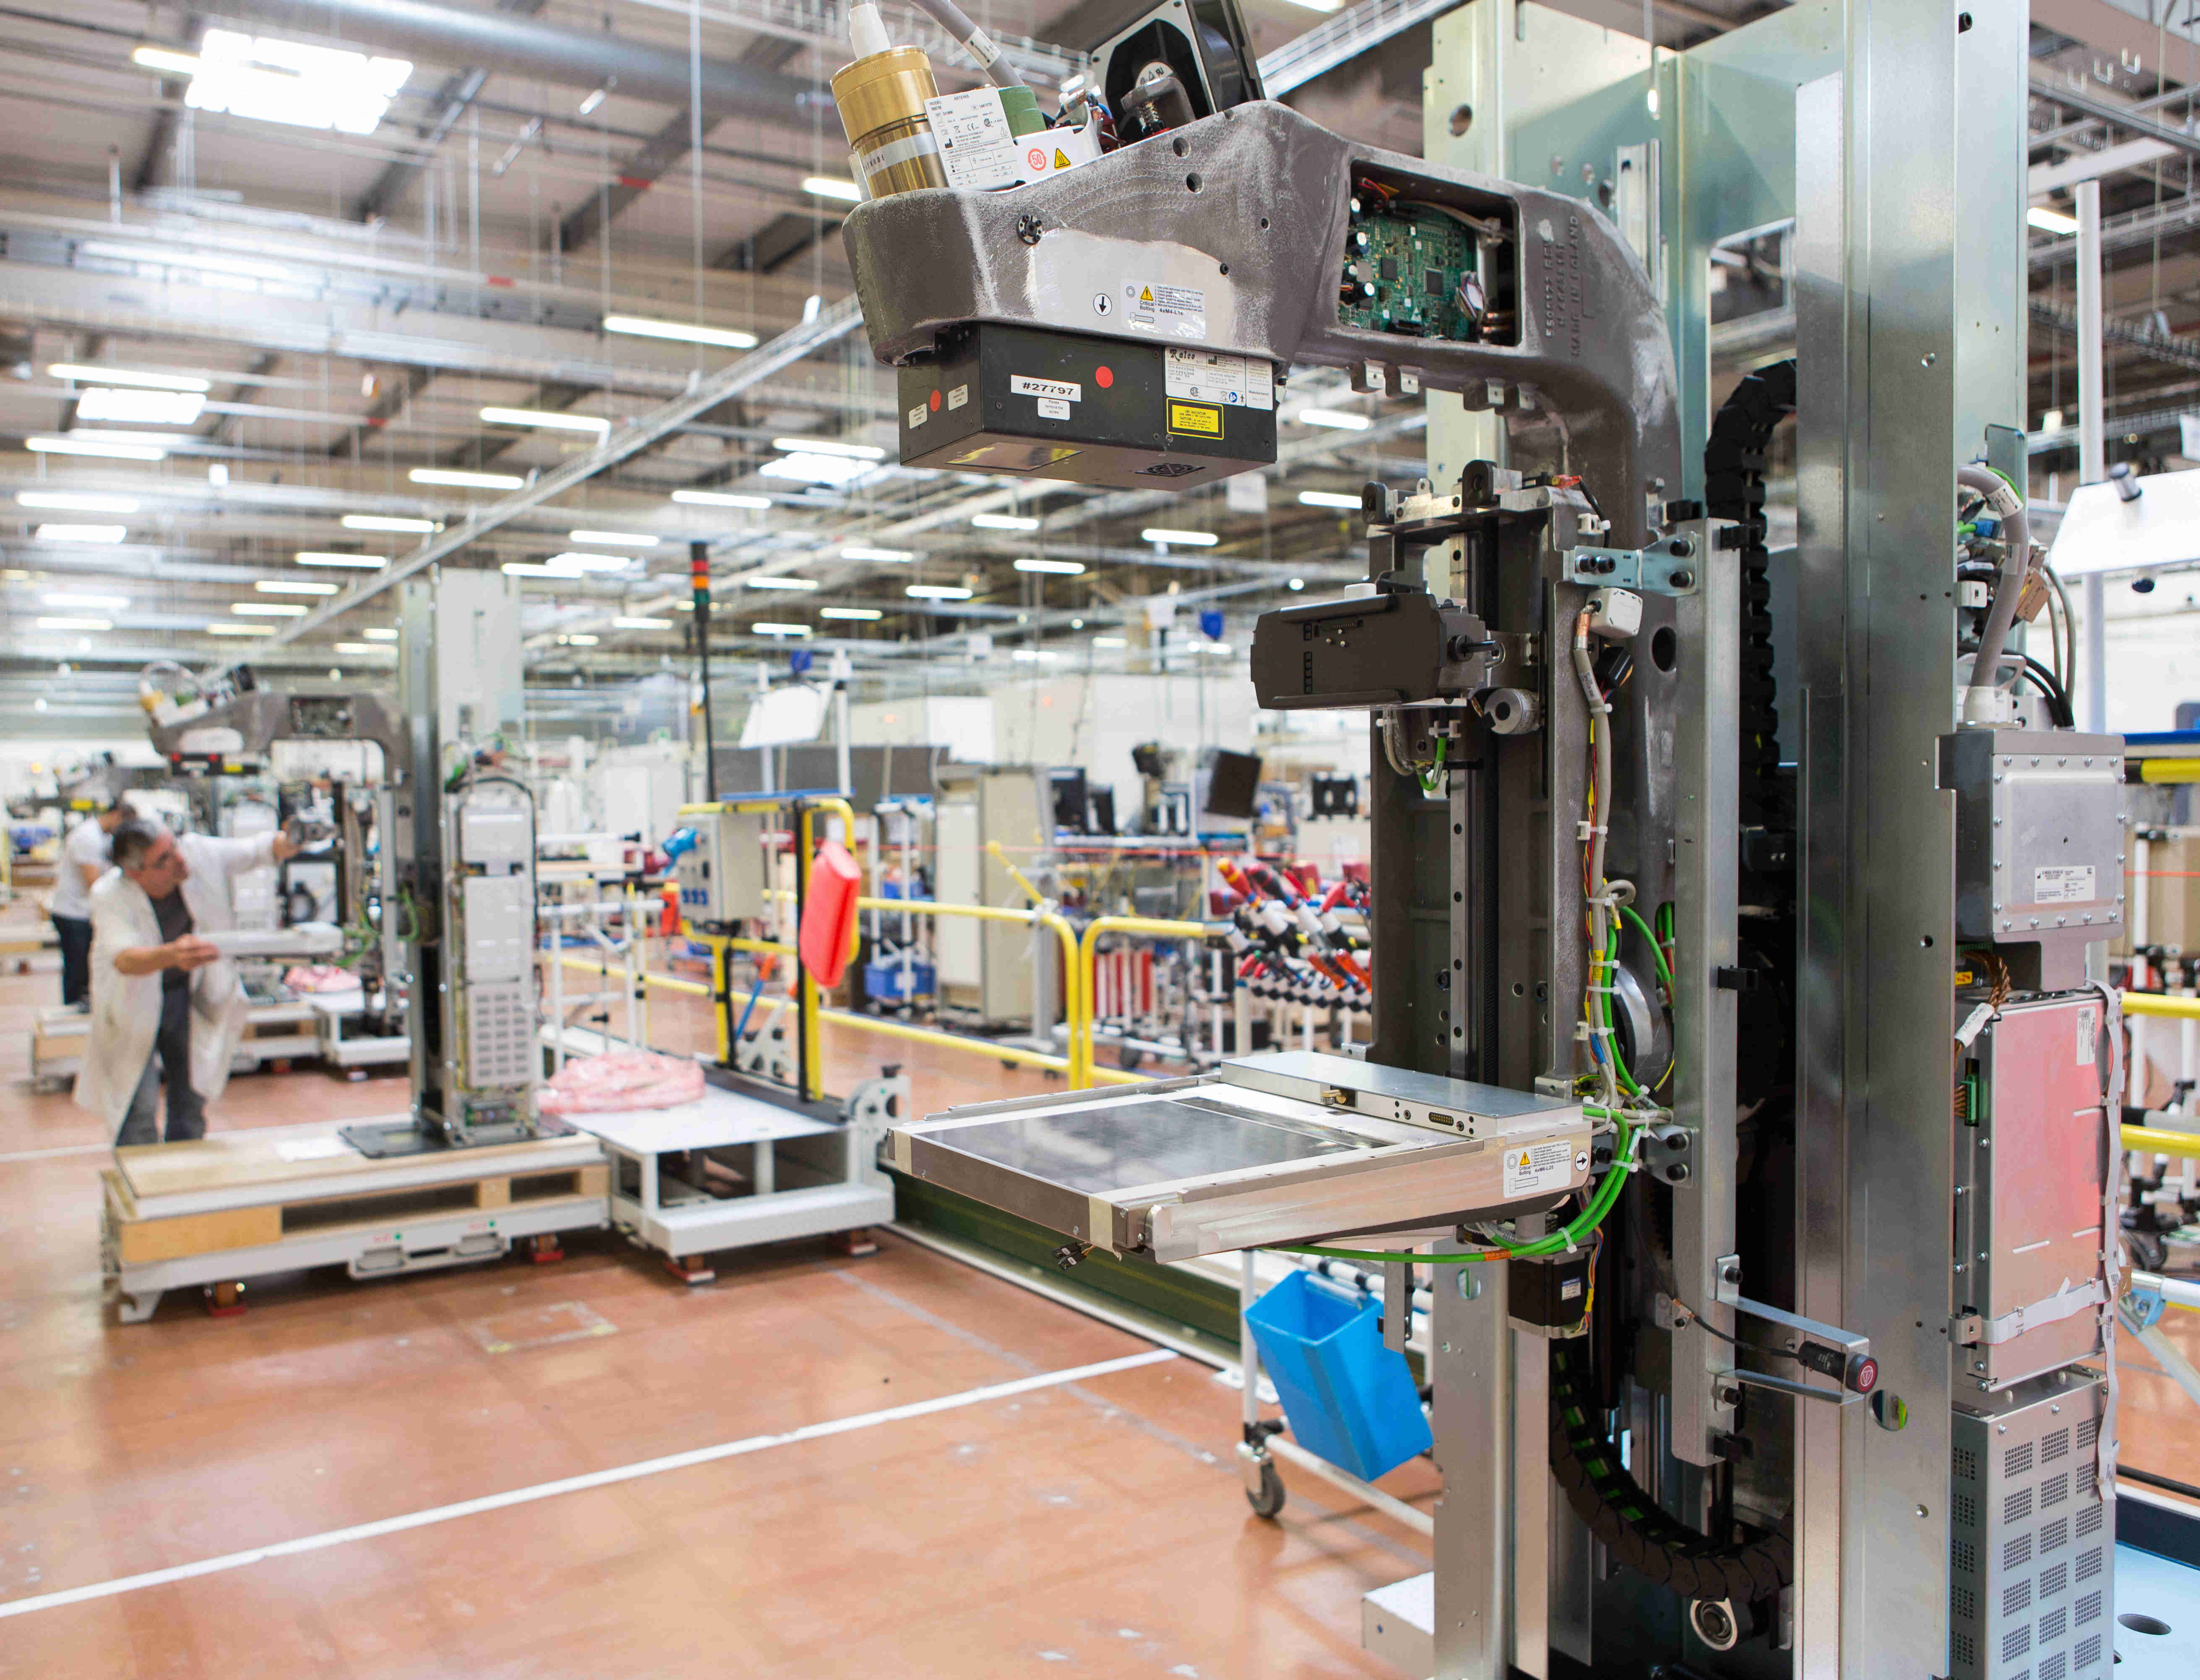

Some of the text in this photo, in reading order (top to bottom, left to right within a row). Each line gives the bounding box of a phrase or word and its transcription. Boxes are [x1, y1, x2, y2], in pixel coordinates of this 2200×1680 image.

[1032, 154, 1043, 165] 50
[1170, 348, 1195, 362] Ralco
[1022, 382, 1074, 395] #27797
